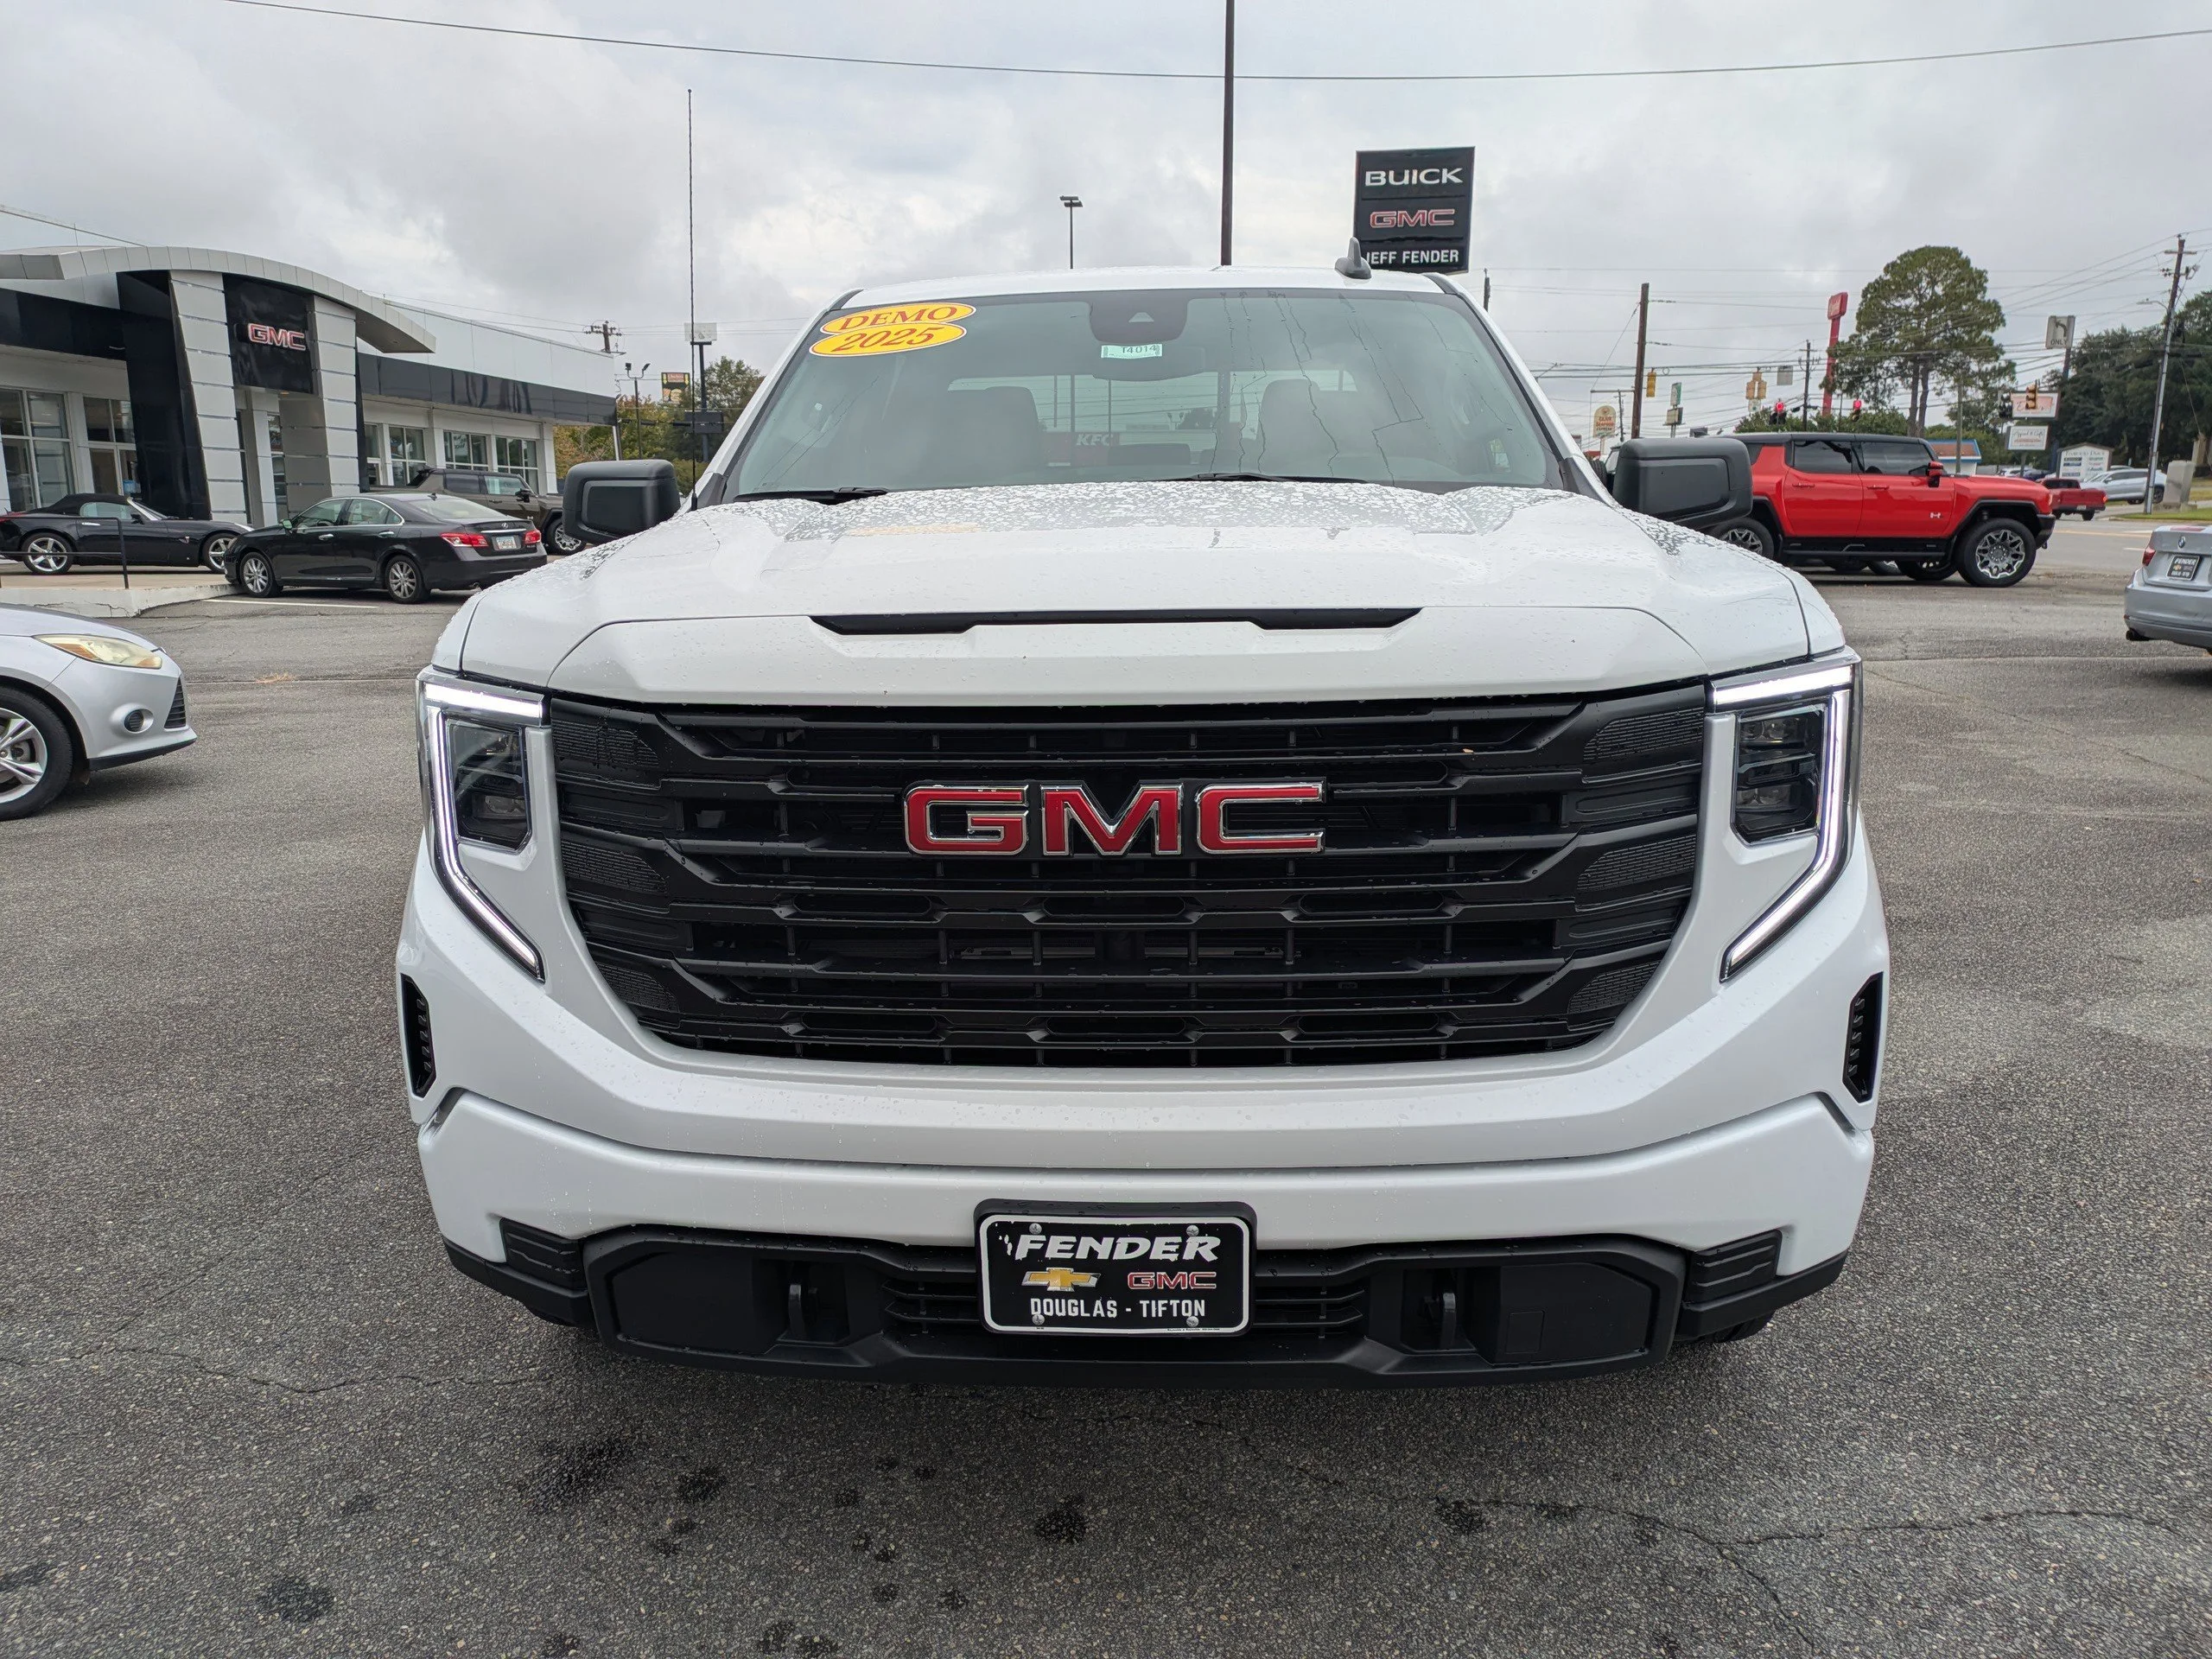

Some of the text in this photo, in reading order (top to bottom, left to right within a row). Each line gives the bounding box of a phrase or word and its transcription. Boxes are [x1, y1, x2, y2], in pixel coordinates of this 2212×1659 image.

[1365, 168, 1463, 187] BUICK
[1370, 208, 1455, 228] GMC
[1402, 250, 1459, 264] FENDER
[840, 307, 957, 330] DEMO
[248, 323, 306, 351] GMC
[831, 327, 944, 352] 2025
[1076, 434, 1113, 446] KFC
[903, 783, 1326, 855] GMC
[1015, 1234, 1221, 1262] FENDER
[1128, 1272, 1217, 1289] GMC
[1030, 1298, 1117, 1318] DOUGLAS
[1140, 1300, 1205, 1317] TIFTON
